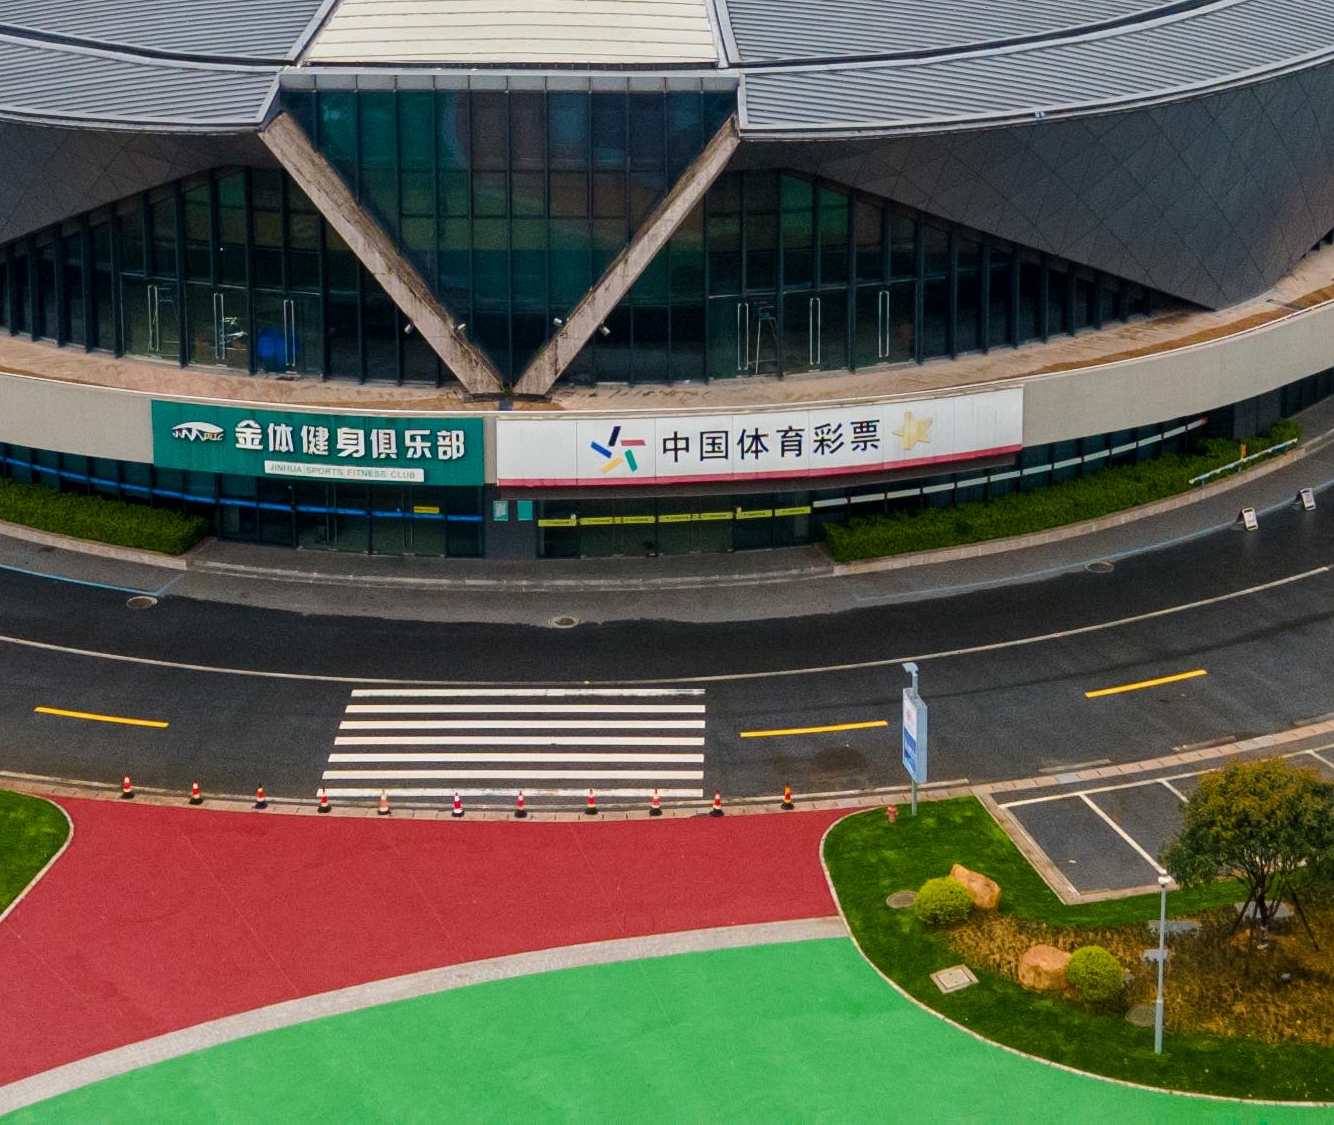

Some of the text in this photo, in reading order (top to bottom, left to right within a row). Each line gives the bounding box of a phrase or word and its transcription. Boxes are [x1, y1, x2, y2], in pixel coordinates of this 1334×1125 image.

[235, 419, 465, 460] 金体健身俱乐部
[662, 419, 881, 463] 中国体育彩票
[269, 464, 416, 479] JINHUA SPORTS FITNESS CLUB
